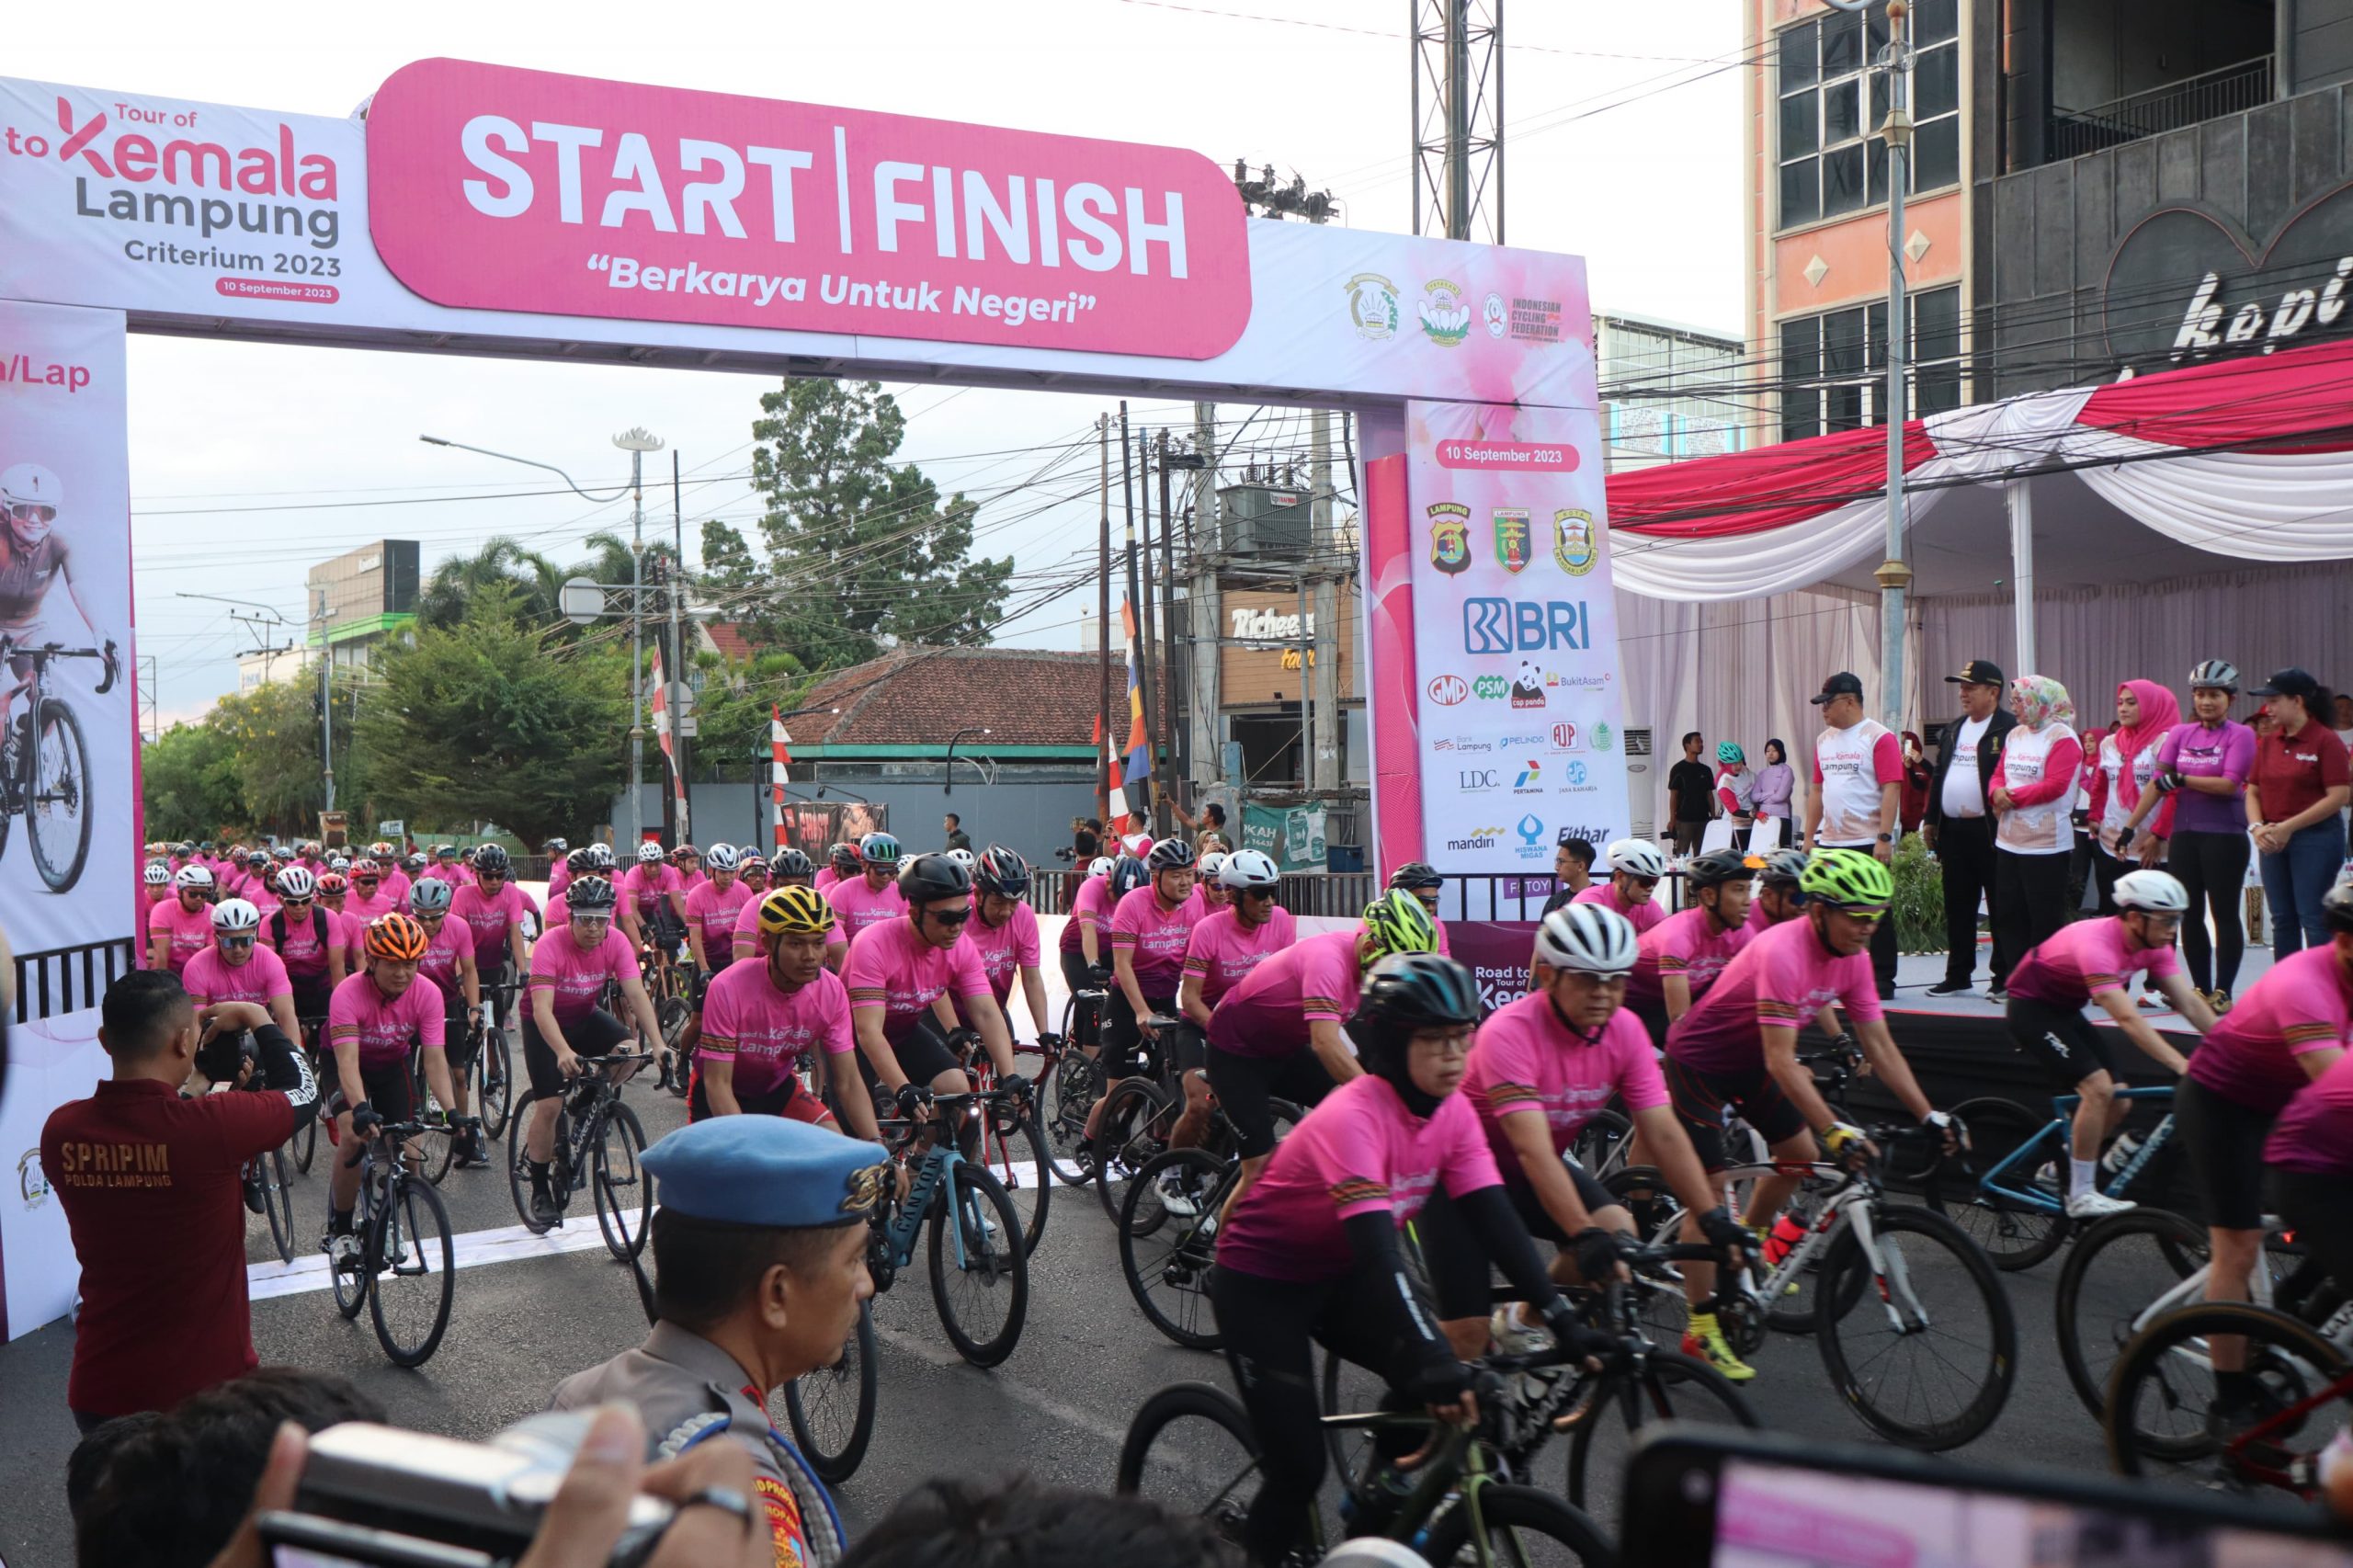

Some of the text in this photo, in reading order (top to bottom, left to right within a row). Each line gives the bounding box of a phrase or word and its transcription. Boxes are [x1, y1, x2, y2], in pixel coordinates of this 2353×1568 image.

[115, 103, 197, 128] Tour of
[6, 96, 337, 202] to Kemala
[460, 114, 1188, 279] START FINISH
[76, 176, 339, 249] Lampung
[124, 240, 341, 277] Criterium 2023
[223, 281, 332, 299] 10 September 2023
[820, 275, 941, 314] Untuk
[1512, 298, 1562, 314] INDONESIAN
[1512, 311, 1547, 324] CYCLING
[1511, 324, 1560, 337] FEDERATION
[0, 354, 90, 393] /Lap
[1446, 447, 1563, 464] 10 September 2023
[1429, 504, 1469, 517] LAMPUNG
[1232, 608, 1314, 639] Richee
[1515, 600, 1590, 651] BRI
[1430, 676, 1468, 705] GMP
[1477, 679, 1506, 695] PSM
[1512, 698, 1545, 709] cap panda
[1457, 742, 1492, 752] Lampung
[1509, 736, 1545, 744] PELINDO
[1952, 754, 1976, 763] mpun
[2005, 763, 2039, 775] ampung
[1448, 836, 1495, 850] mandiri
[1515, 846, 1548, 854] HISWANA
[1520, 851, 1544, 859] MIGAS
[1510, 880, 1552, 894] FTOY
[576, 970, 606, 983] Kemal
[1475, 967, 1513, 978] Road
[61, 1142, 169, 1172] SPRIPIM
[64, 1174, 173, 1187] POLDA LAMPUNG
[896, 1157, 940, 1233] CANYON
